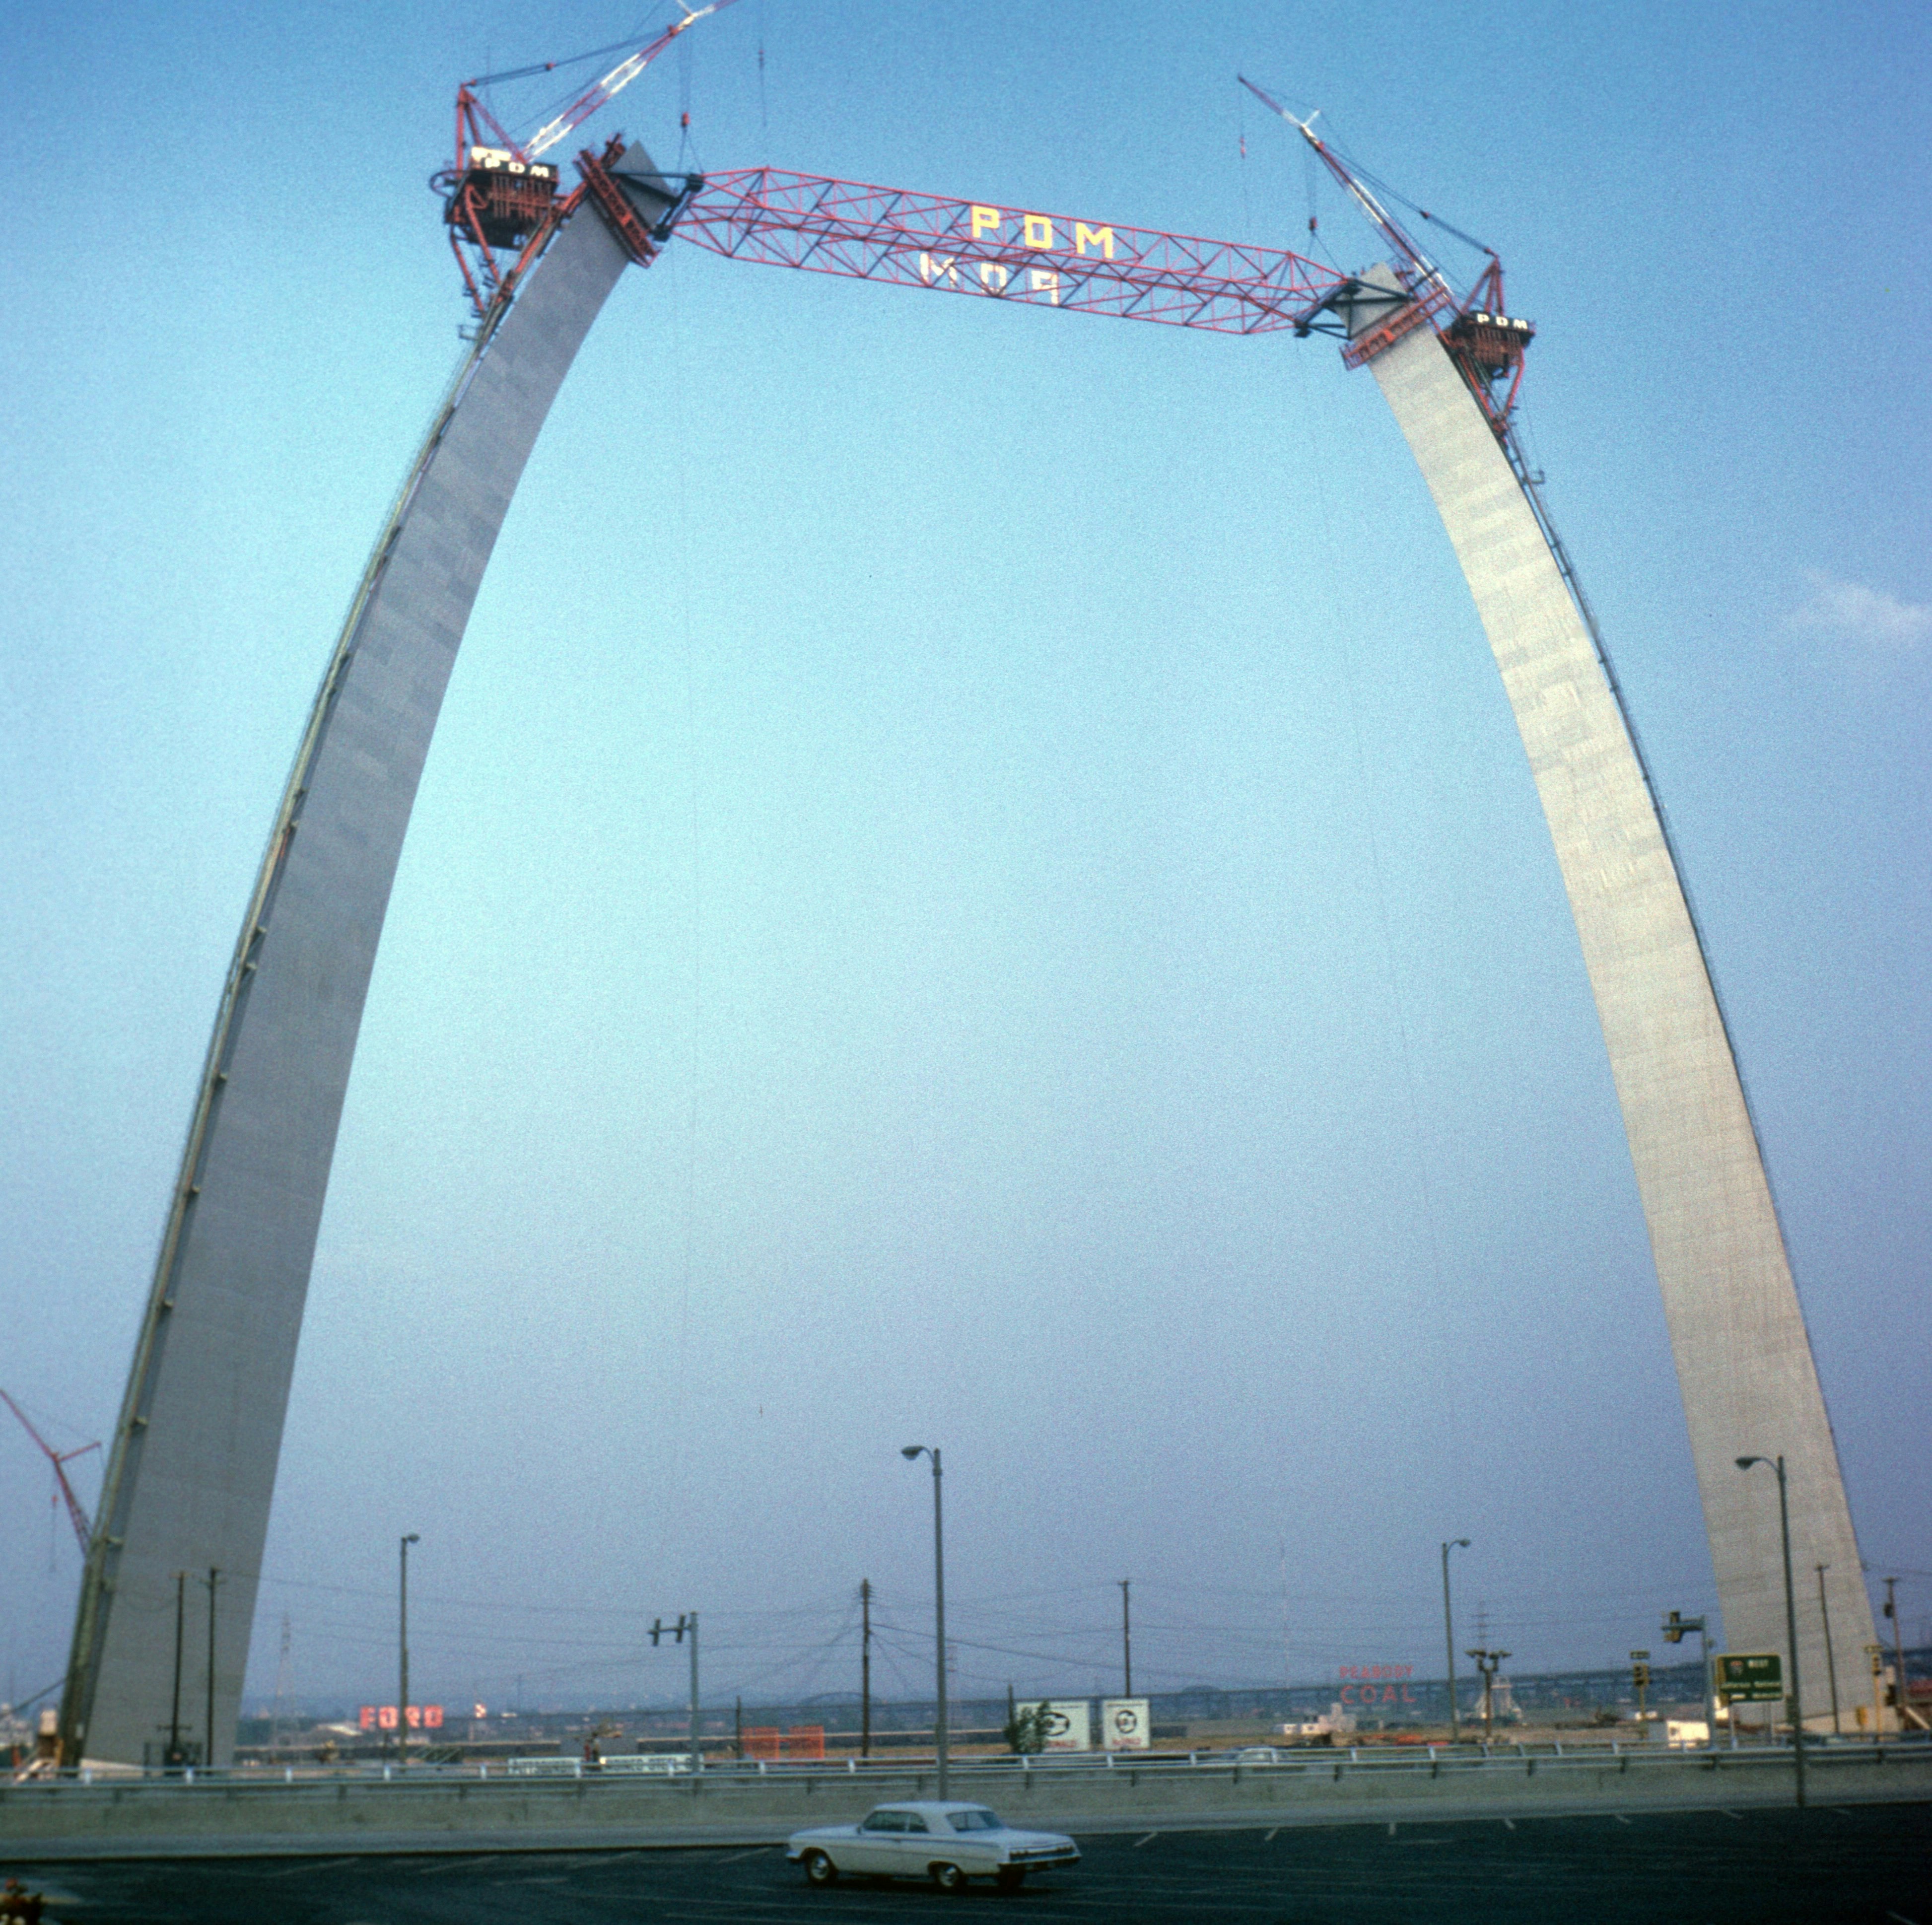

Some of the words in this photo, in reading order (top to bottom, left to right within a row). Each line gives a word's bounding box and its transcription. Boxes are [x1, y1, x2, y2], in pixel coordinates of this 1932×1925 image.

[484, 157, 549, 178] PDM
[971, 206, 1113, 259] PDM
[1476, 313, 1528, 330] PDM
[1339, 1665, 1414, 1679] PEABODY
[1341, 1683, 1417, 1704] COAL
[360, 1705, 444, 1729] FORD
